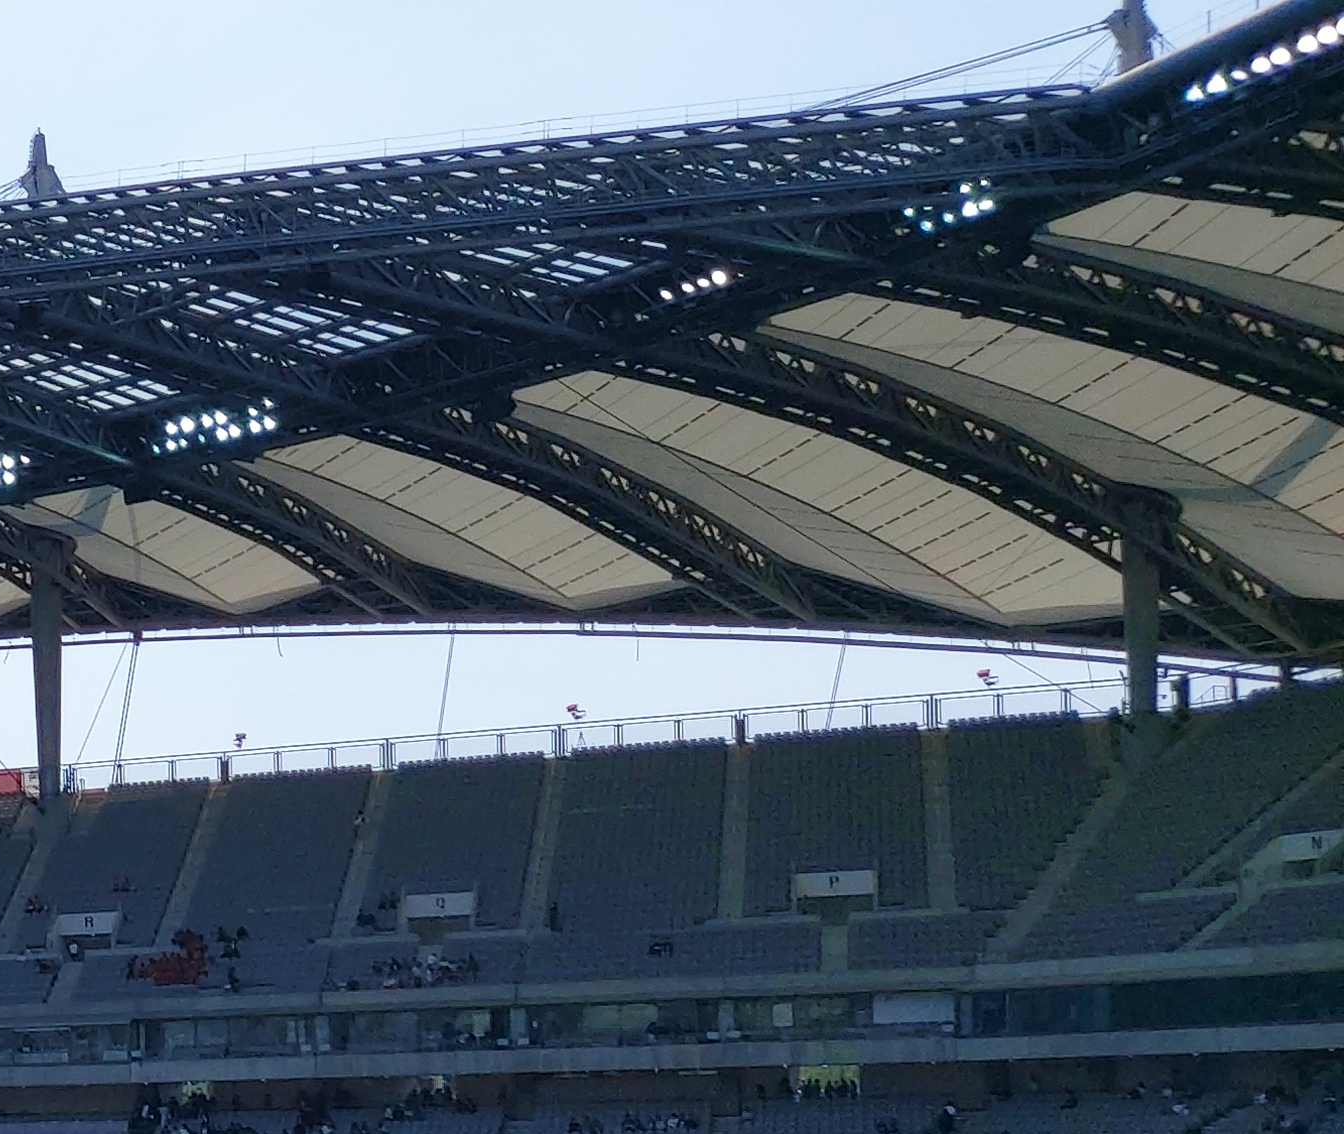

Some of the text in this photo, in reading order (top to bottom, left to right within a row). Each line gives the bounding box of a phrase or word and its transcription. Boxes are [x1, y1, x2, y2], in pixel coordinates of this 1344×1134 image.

[1310, 836, 1322, 850] N
[829, 876, 839, 888] P
[85, 916, 94, 927] R
